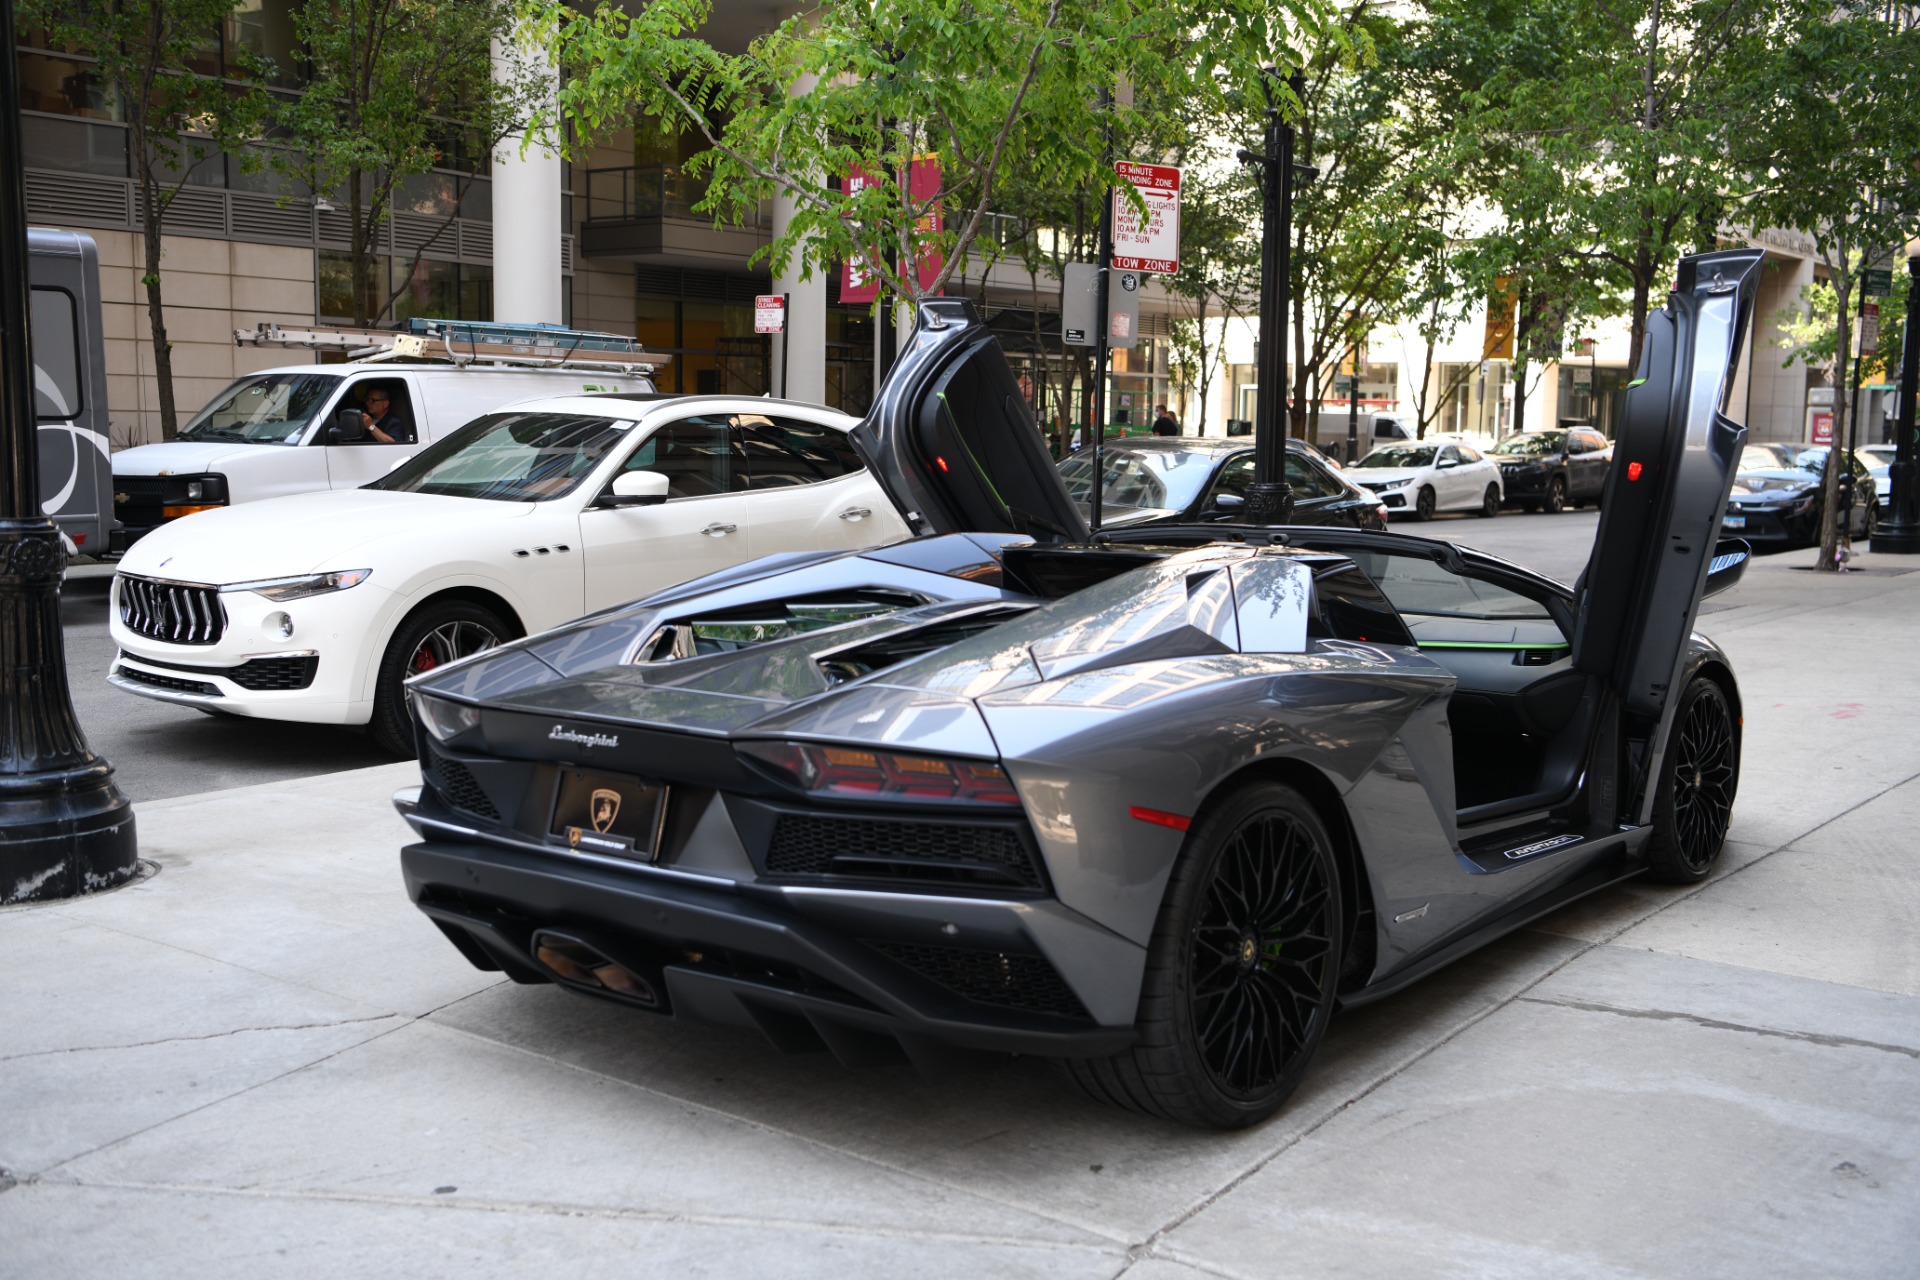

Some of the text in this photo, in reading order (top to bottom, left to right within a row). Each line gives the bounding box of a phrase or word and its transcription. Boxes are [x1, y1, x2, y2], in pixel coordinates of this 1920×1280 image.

[1119, 164, 1154, 177] 15 MINUTE
[1154, 178, 1173, 188] ZONE
[1118, 206, 1126, 215] 10
[1150, 209, 1161, 218] PM
[1152, 201, 1176, 211] LIGHTS
[1117, 215, 1133, 224] MON
[1117, 224, 1160, 236] 10 AM 6 PM
[1116, 233, 1129, 242] FRI
[1135, 234, 1150, 244] SUN
[1116, 256, 1172, 272] TOW ZONE
[548, 724, 619, 748] Lamborghini
